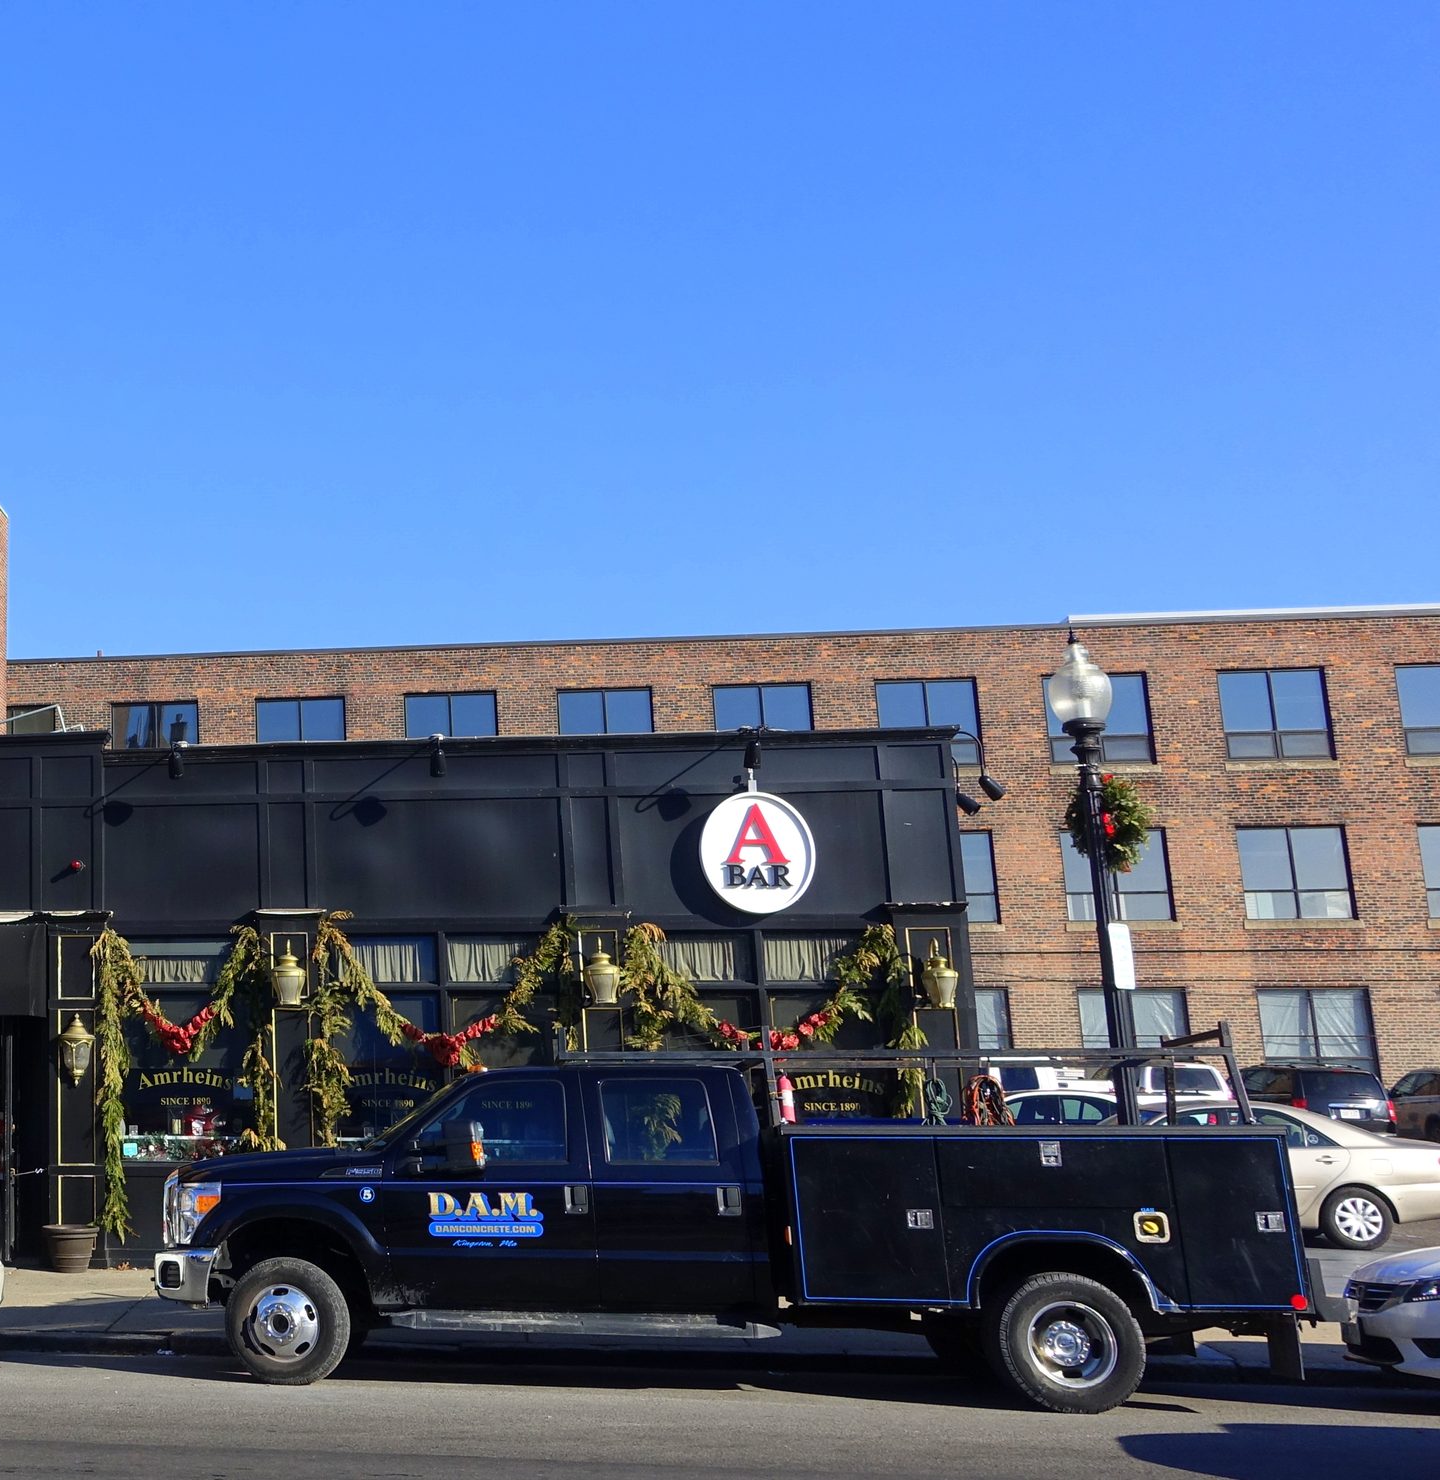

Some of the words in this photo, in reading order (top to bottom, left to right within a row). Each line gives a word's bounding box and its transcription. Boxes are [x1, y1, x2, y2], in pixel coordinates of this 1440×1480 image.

[724, 803, 792, 865] A
[723, 864, 794, 888] BAR
[138, 1067, 233, 1091] Amrheins
[791, 1069, 885, 1095] mrheins
[160, 1097, 190, 1106] SINCE
[192, 1096, 211, 1106] 1890
[362, 1099, 391, 1108] SINCE
[481, 1100, 512, 1109] SINCE
[804, 1102, 838, 1111] SINCE
[363, 1189, 372, 1200] 5
[428, 1192, 542, 1220] D.A.M.
[435, 1225, 536, 1234] DAMCONCRETE.COM
